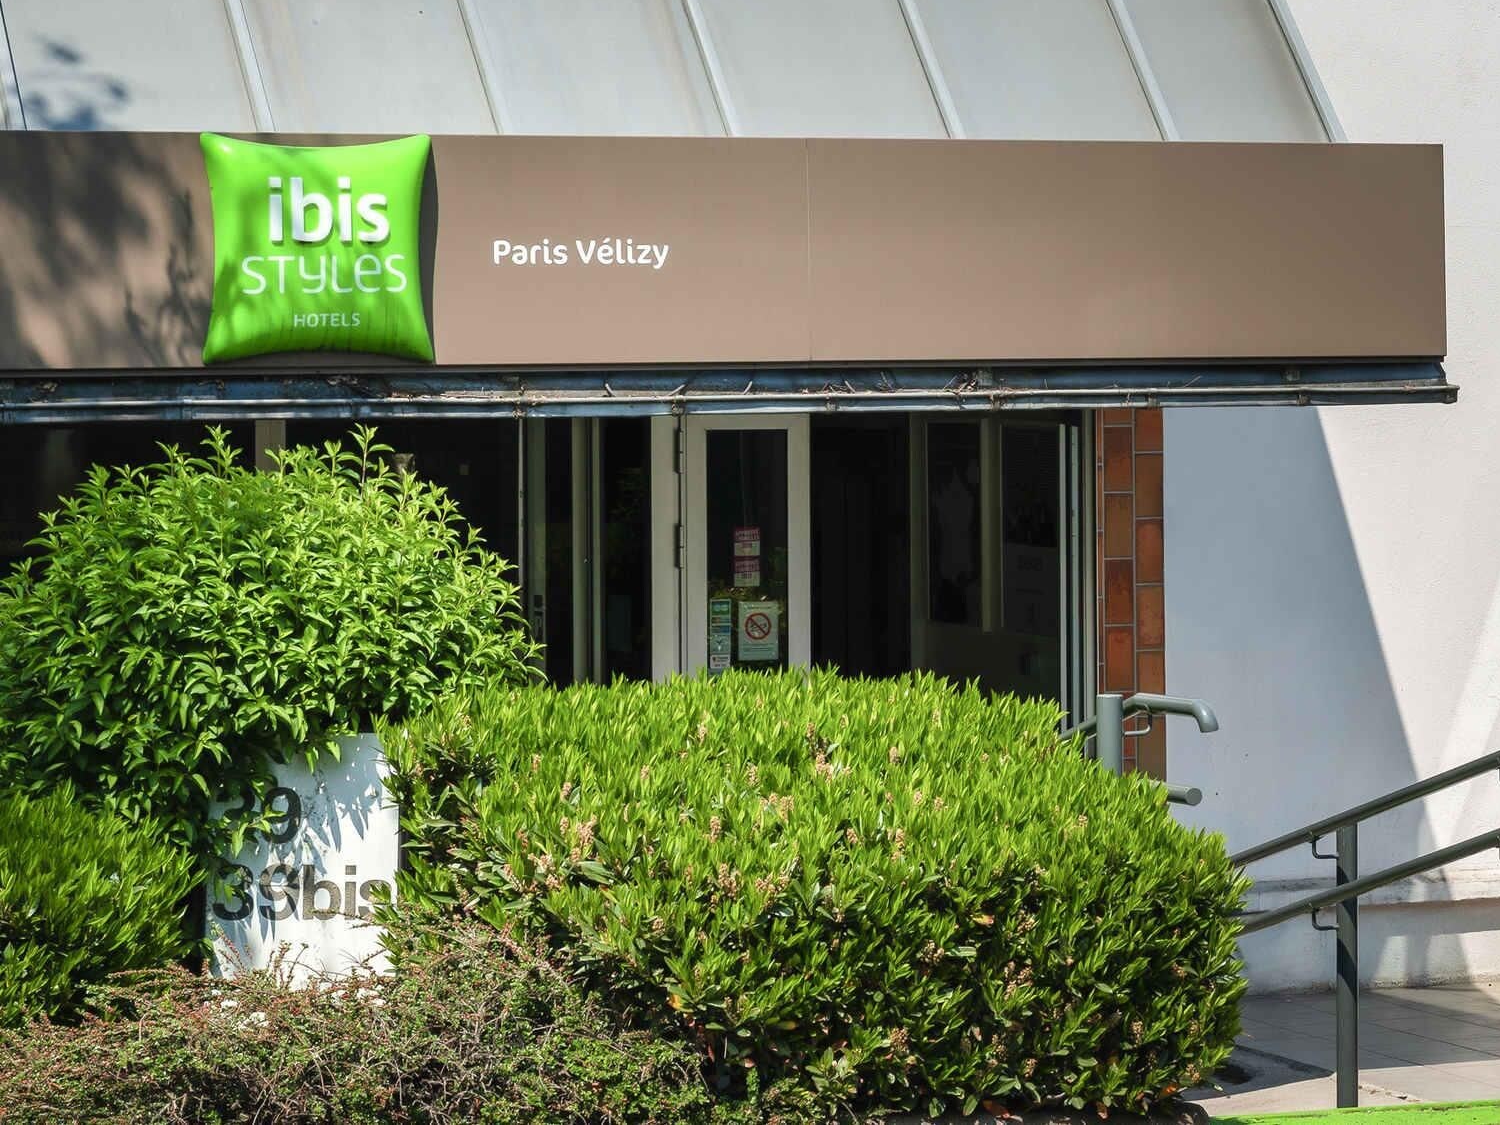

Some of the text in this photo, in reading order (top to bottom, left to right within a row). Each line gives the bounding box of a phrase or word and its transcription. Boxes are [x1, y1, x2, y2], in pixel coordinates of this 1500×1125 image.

[266, 176, 391, 245] ibis
[492, 237, 670, 270] Paris Vélizy
[293, 312, 361, 329] HOTELS
